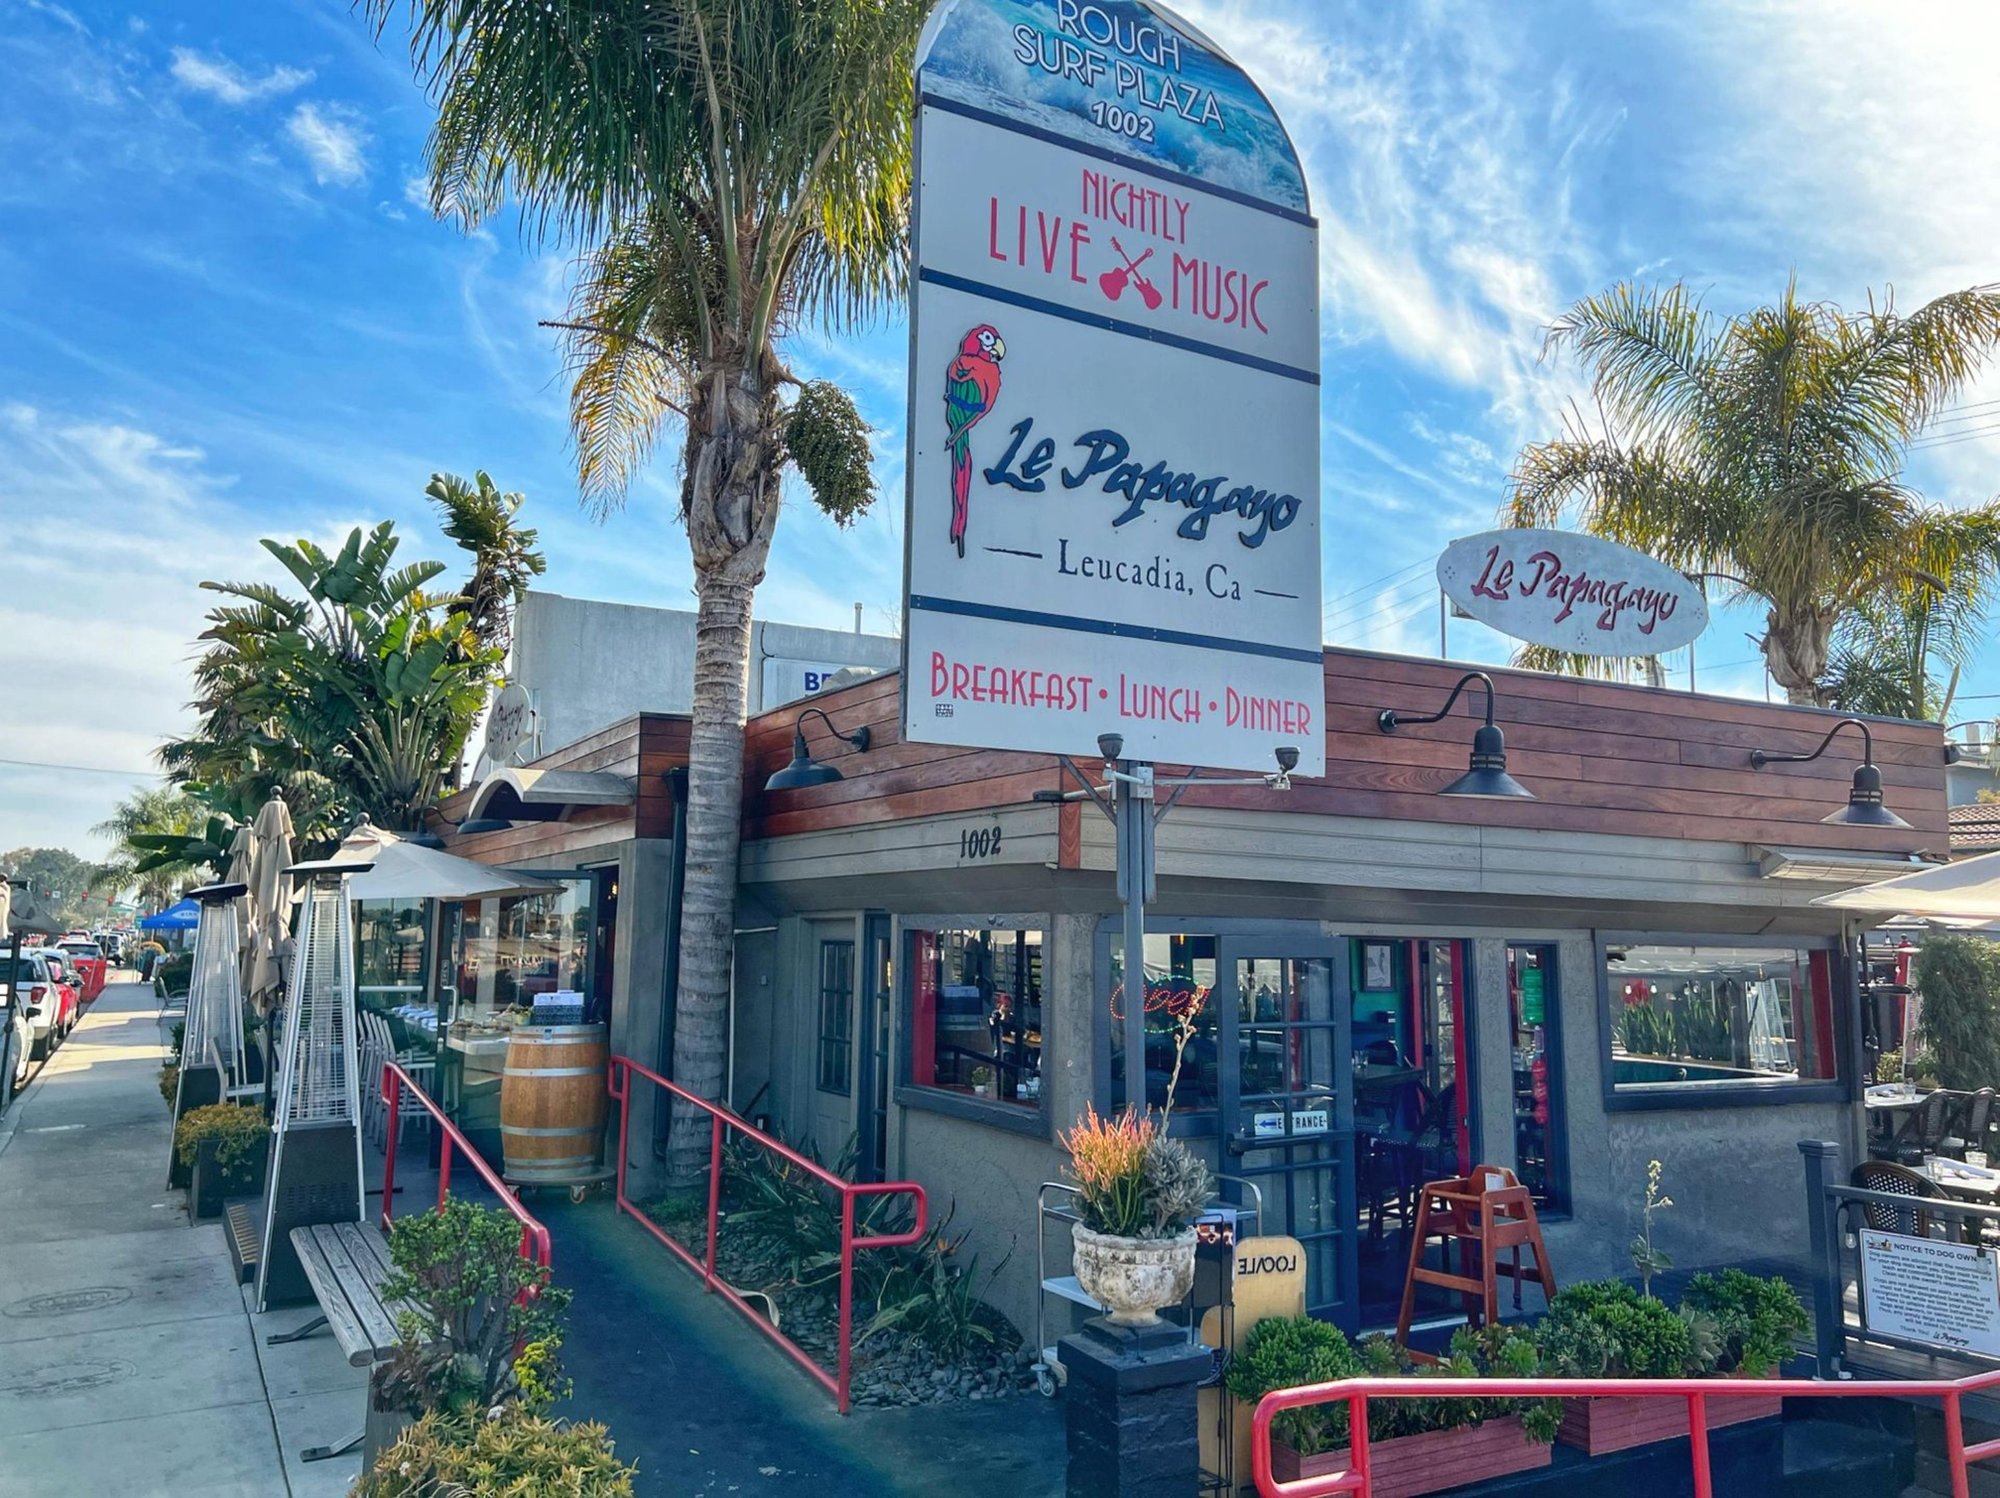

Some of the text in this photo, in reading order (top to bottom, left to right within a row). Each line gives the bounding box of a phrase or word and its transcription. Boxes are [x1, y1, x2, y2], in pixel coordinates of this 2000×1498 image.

[1057, 0, 1181, 73] ROUGH
[1013, 24, 1226, 132] SURF PLAZA
[1091, 101, 1156, 144] 1002
[1082, 168, 1190, 245] NIGHTLY
[989, 197, 1269, 335] LIVE MUSIC
[983, 417, 1302, 549] Le Papagayo
[1057, 539, 1241, 601] Leucadia, Ca
[1471, 545, 1679, 635] Le Papagayo
[931, 651, 1312, 736] BREAKFAST LUNCH DINNER
[960, 826, 1001, 858] 1002
[1893, 1243, 1992, 1264] NOTICE TO DOG OWNS
